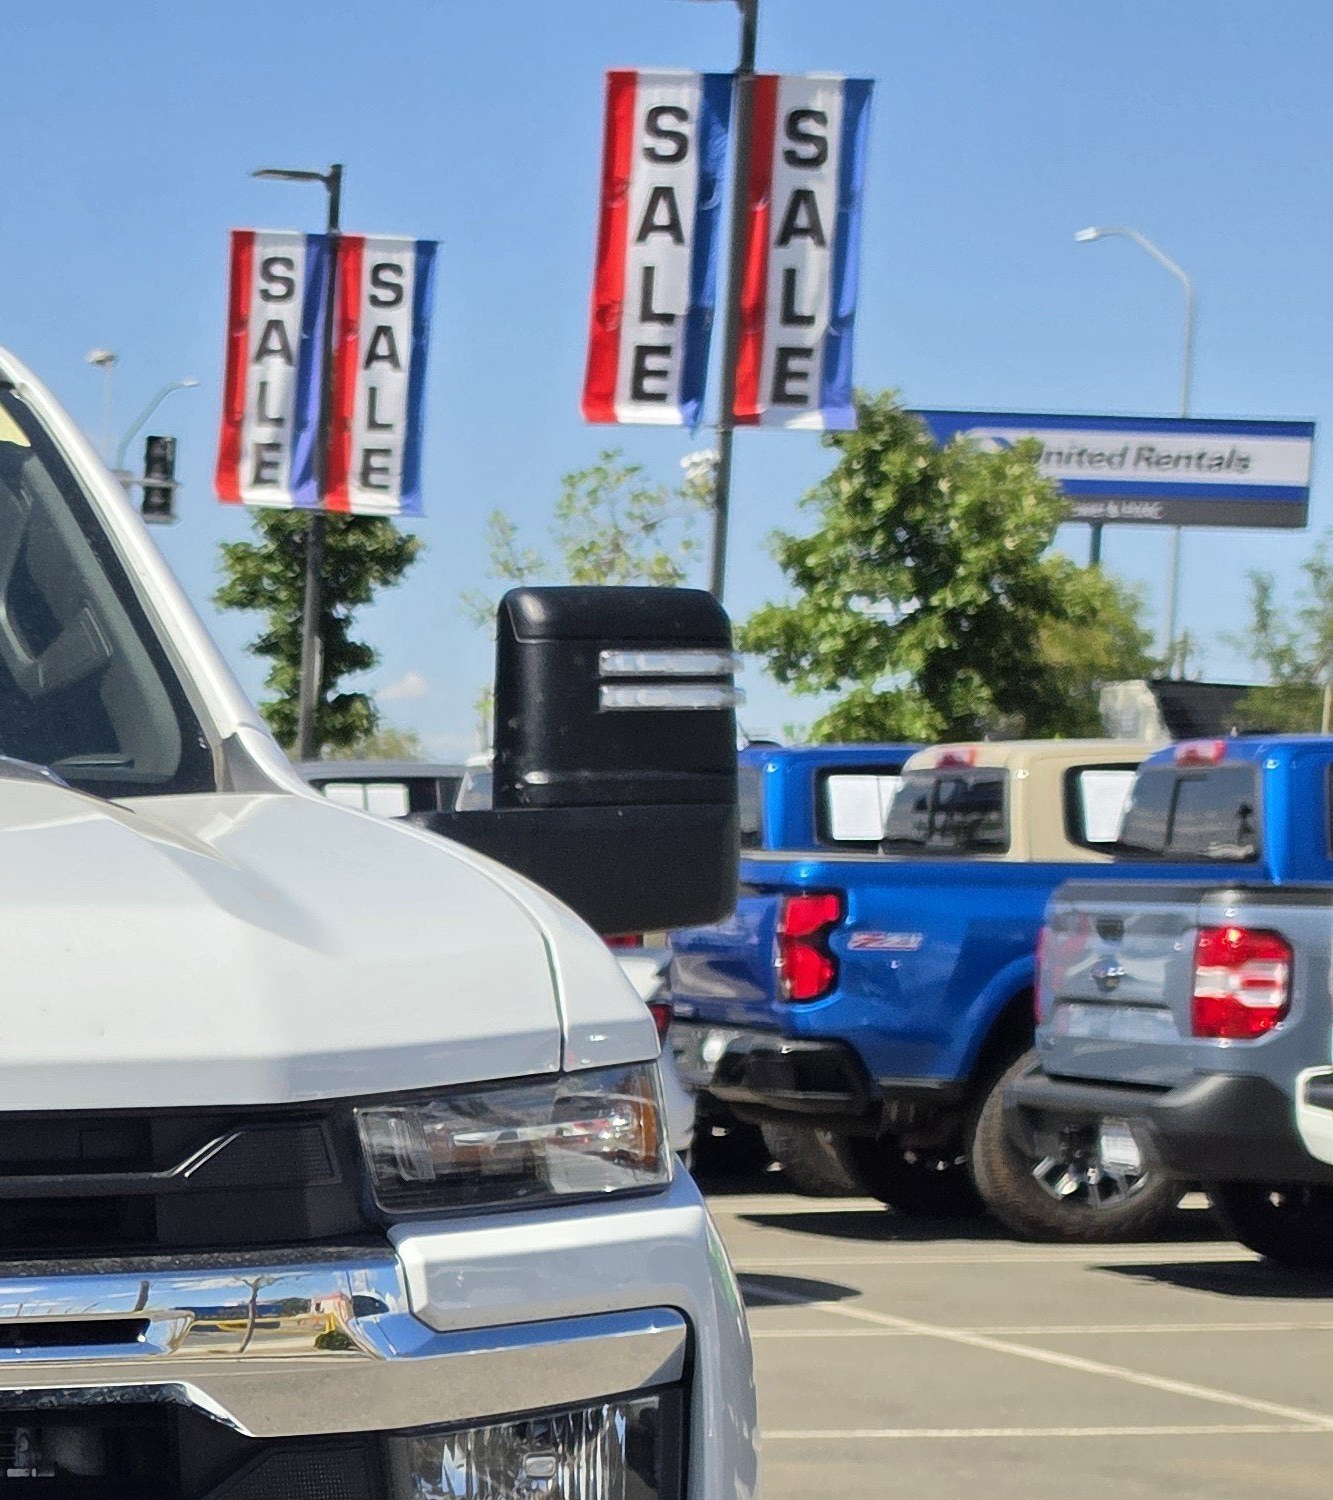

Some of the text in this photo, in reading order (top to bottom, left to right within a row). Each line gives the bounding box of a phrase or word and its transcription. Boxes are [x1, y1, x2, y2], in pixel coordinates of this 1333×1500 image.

[630, 105, 690, 402] SALE
[771, 108, 829, 405] SALE
[251, 256, 296, 486] SALE
[359, 262, 404, 490] SALE
[1036, 445, 1251, 473] nited Rentals
